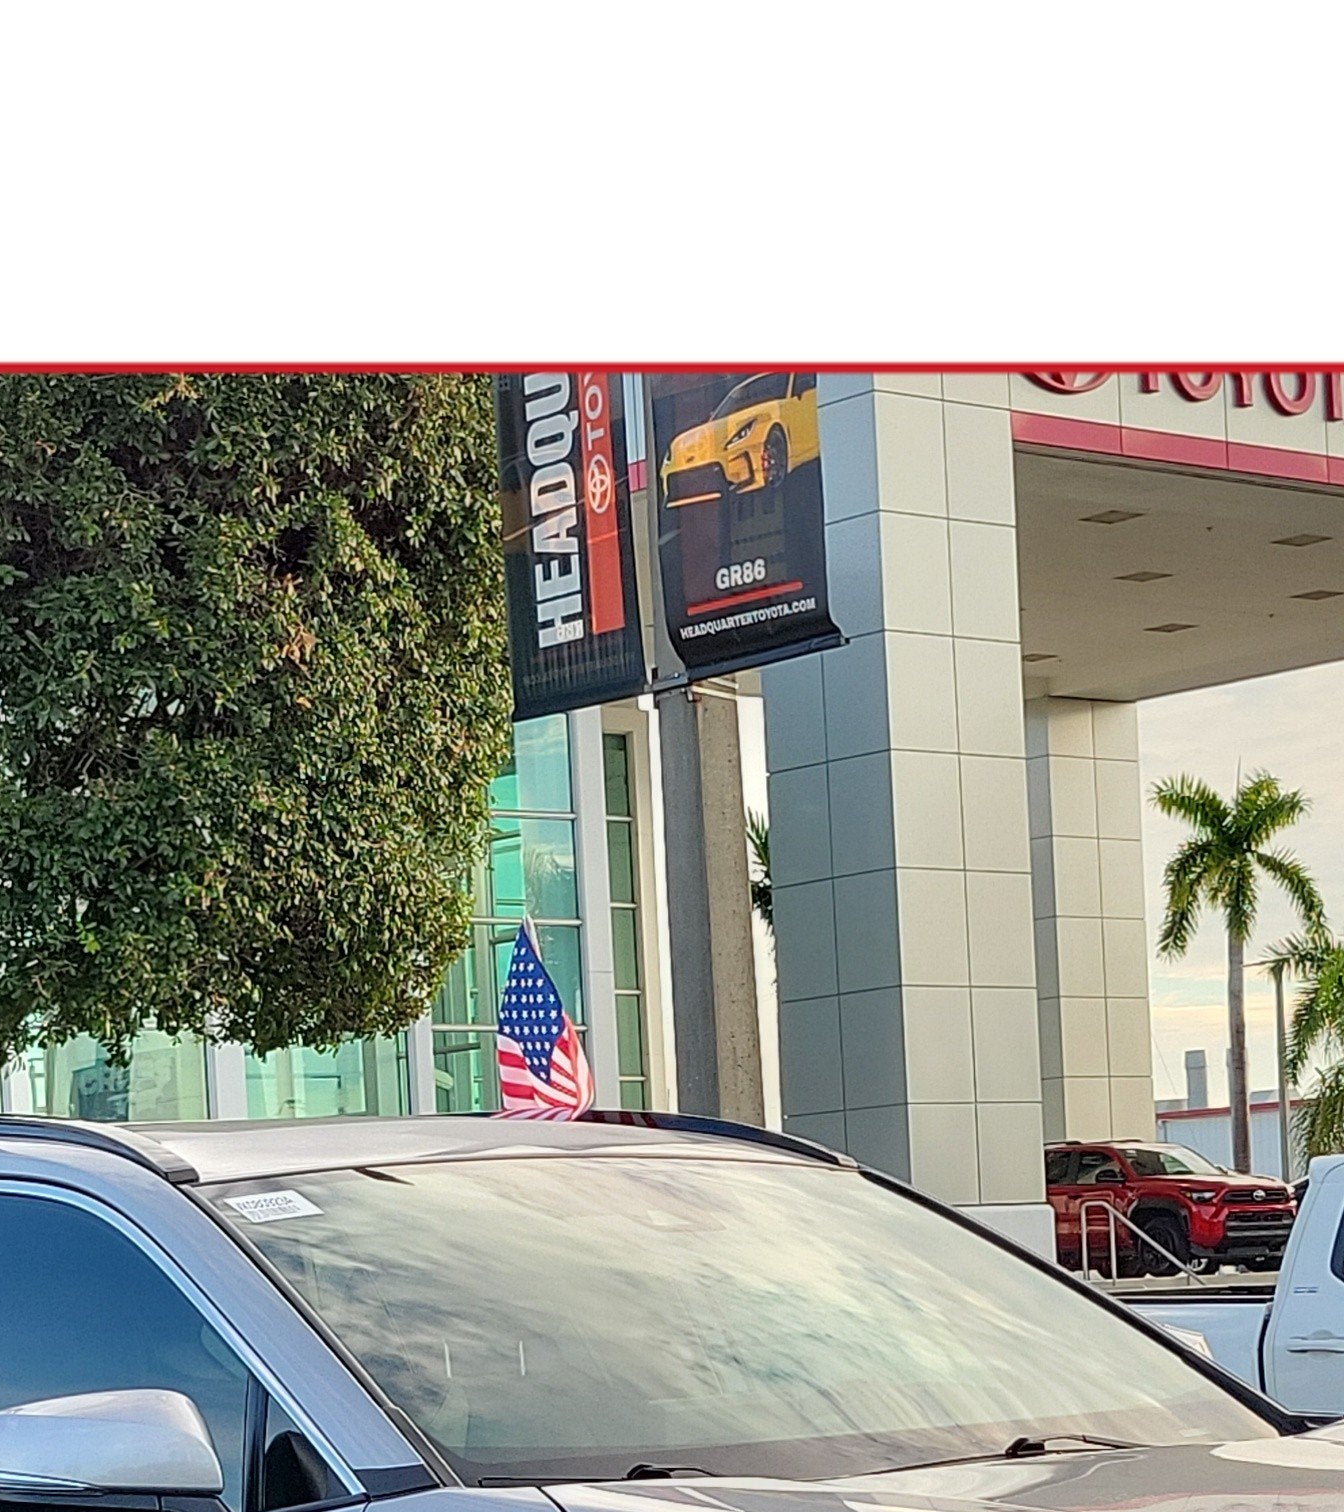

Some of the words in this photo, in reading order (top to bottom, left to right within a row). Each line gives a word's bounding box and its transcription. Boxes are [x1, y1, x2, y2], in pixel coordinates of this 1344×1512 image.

[584, 373, 606, 451] TO
[715, 558, 766, 590] GR86
[679, 597, 816, 640] HEADQUARTERTOYOTA.COM
